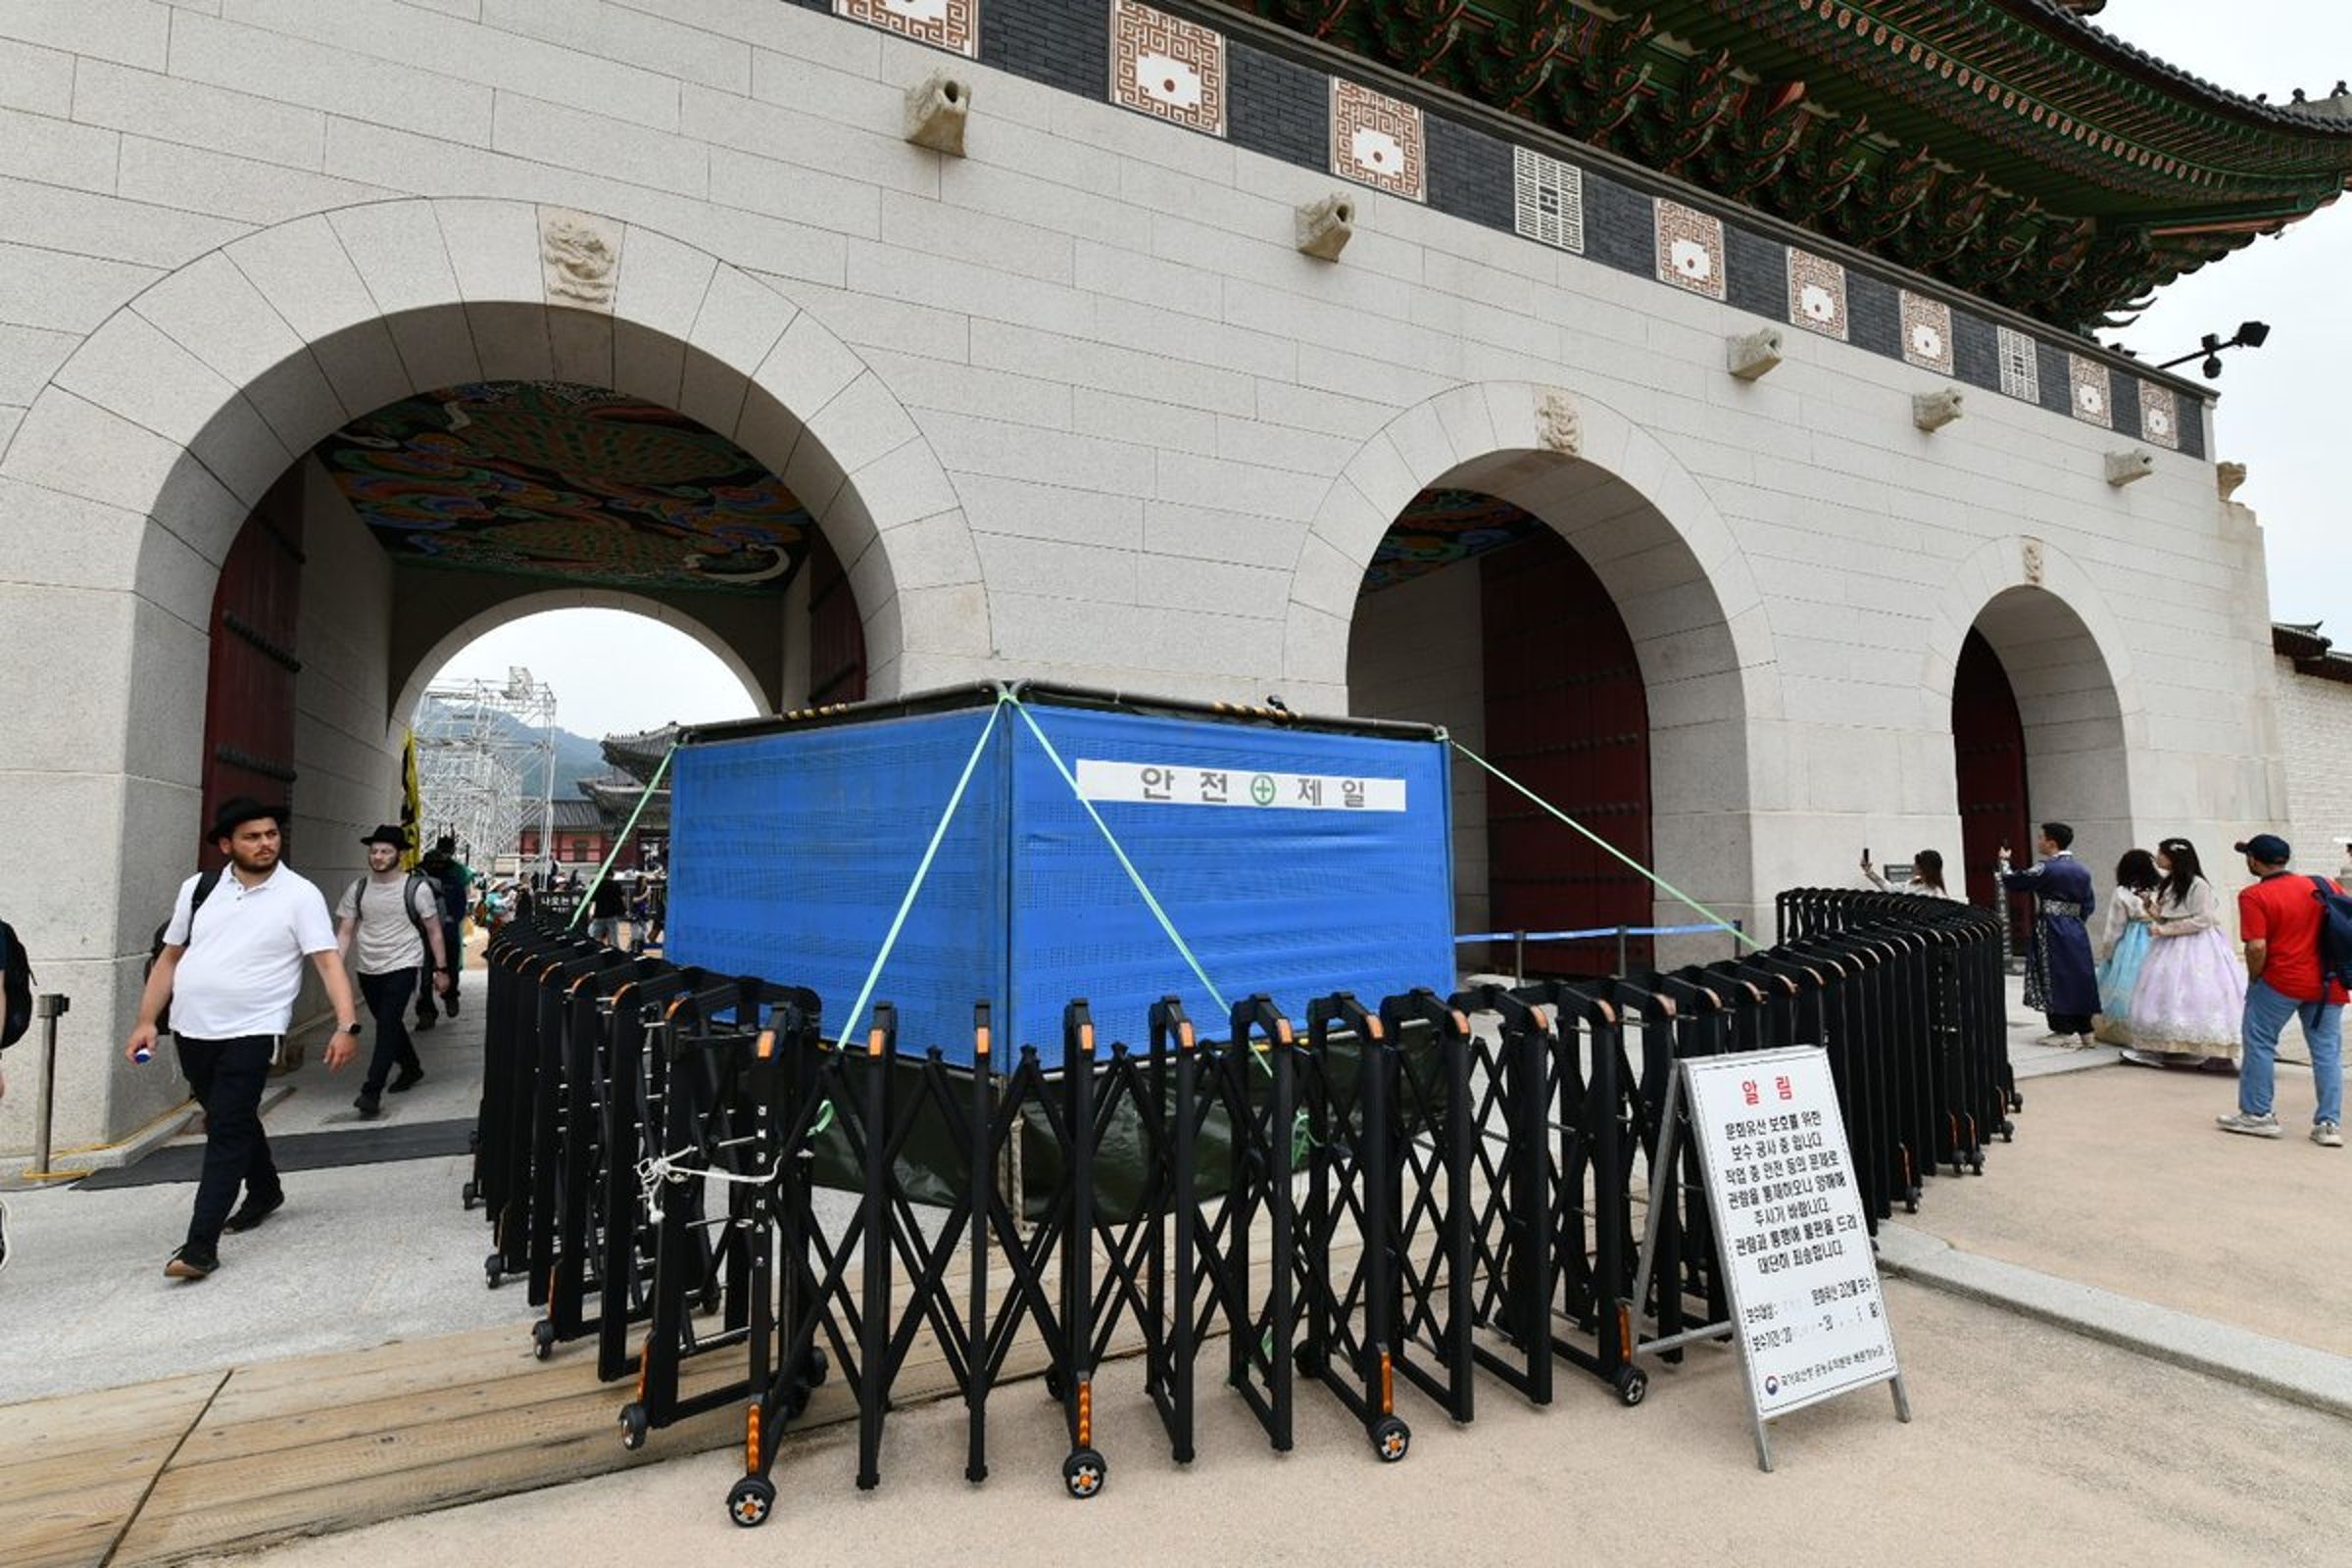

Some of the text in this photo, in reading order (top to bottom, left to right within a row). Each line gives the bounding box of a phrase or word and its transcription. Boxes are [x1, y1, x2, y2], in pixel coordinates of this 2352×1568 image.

[1725, 1111, 1821, 1140] 문화유산 보호를 위한
[1732, 1144, 1752, 1160] 보수
[1756, 1140, 1776, 1157] 공사
[1780, 1137, 1789, 1152] 중
[1725, 1168, 1746, 1184] 작업
[1750, 1165, 1760, 1181] 중
[1764, 1160, 1784, 1179] 안전
